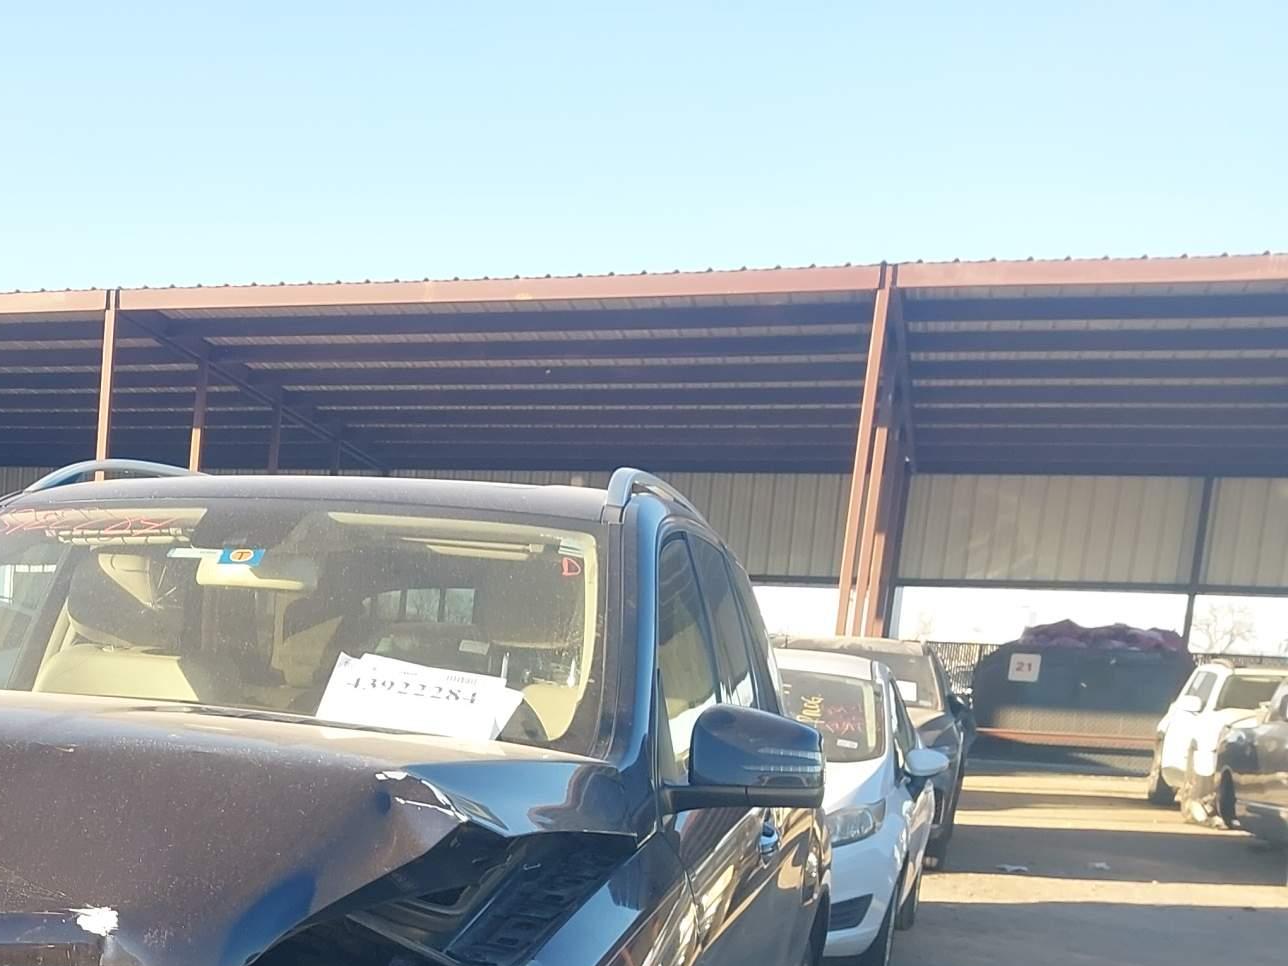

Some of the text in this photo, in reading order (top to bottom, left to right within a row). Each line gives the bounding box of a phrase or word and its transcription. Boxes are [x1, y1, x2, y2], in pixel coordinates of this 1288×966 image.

[562, 557, 582, 576] D
[1015, 661, 1033, 672] 21
[345, 677, 478, 704] 43922284
